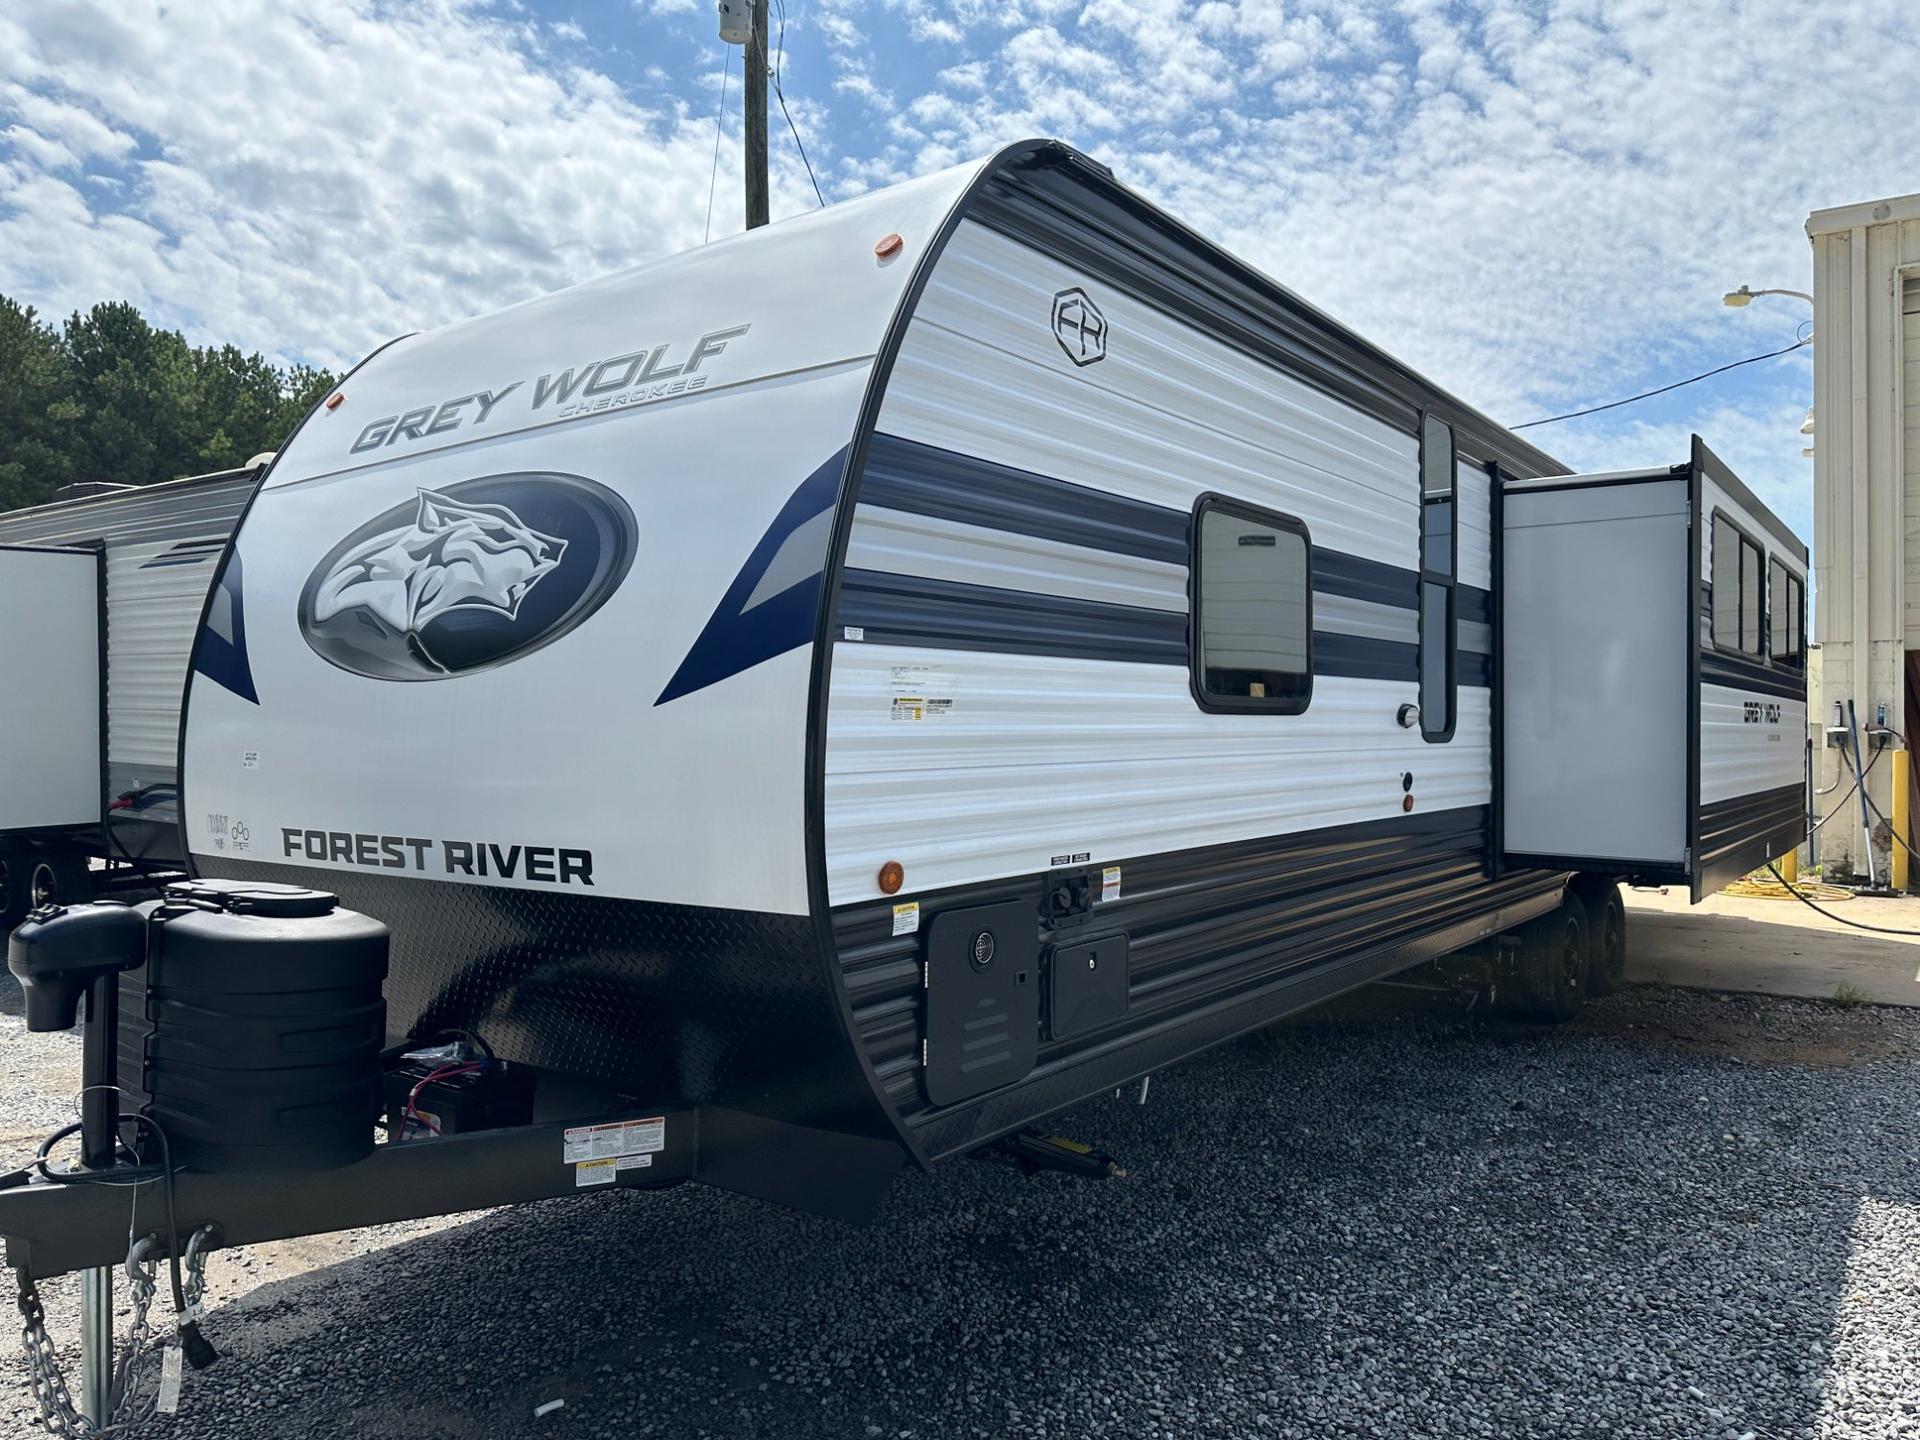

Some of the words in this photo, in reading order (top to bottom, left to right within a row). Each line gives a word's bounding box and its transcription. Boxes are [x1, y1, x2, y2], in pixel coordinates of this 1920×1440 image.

[350, 381, 526, 455] GREY
[531, 323, 751, 410] WOLF
[558, 375, 708, 418] CHEROKEE
[1744, 701, 1762, 723] GREY
[1763, 702, 1780, 723] WOLF
[281, 828, 433, 870] FOREST
[442, 840, 595, 886] RIVER
